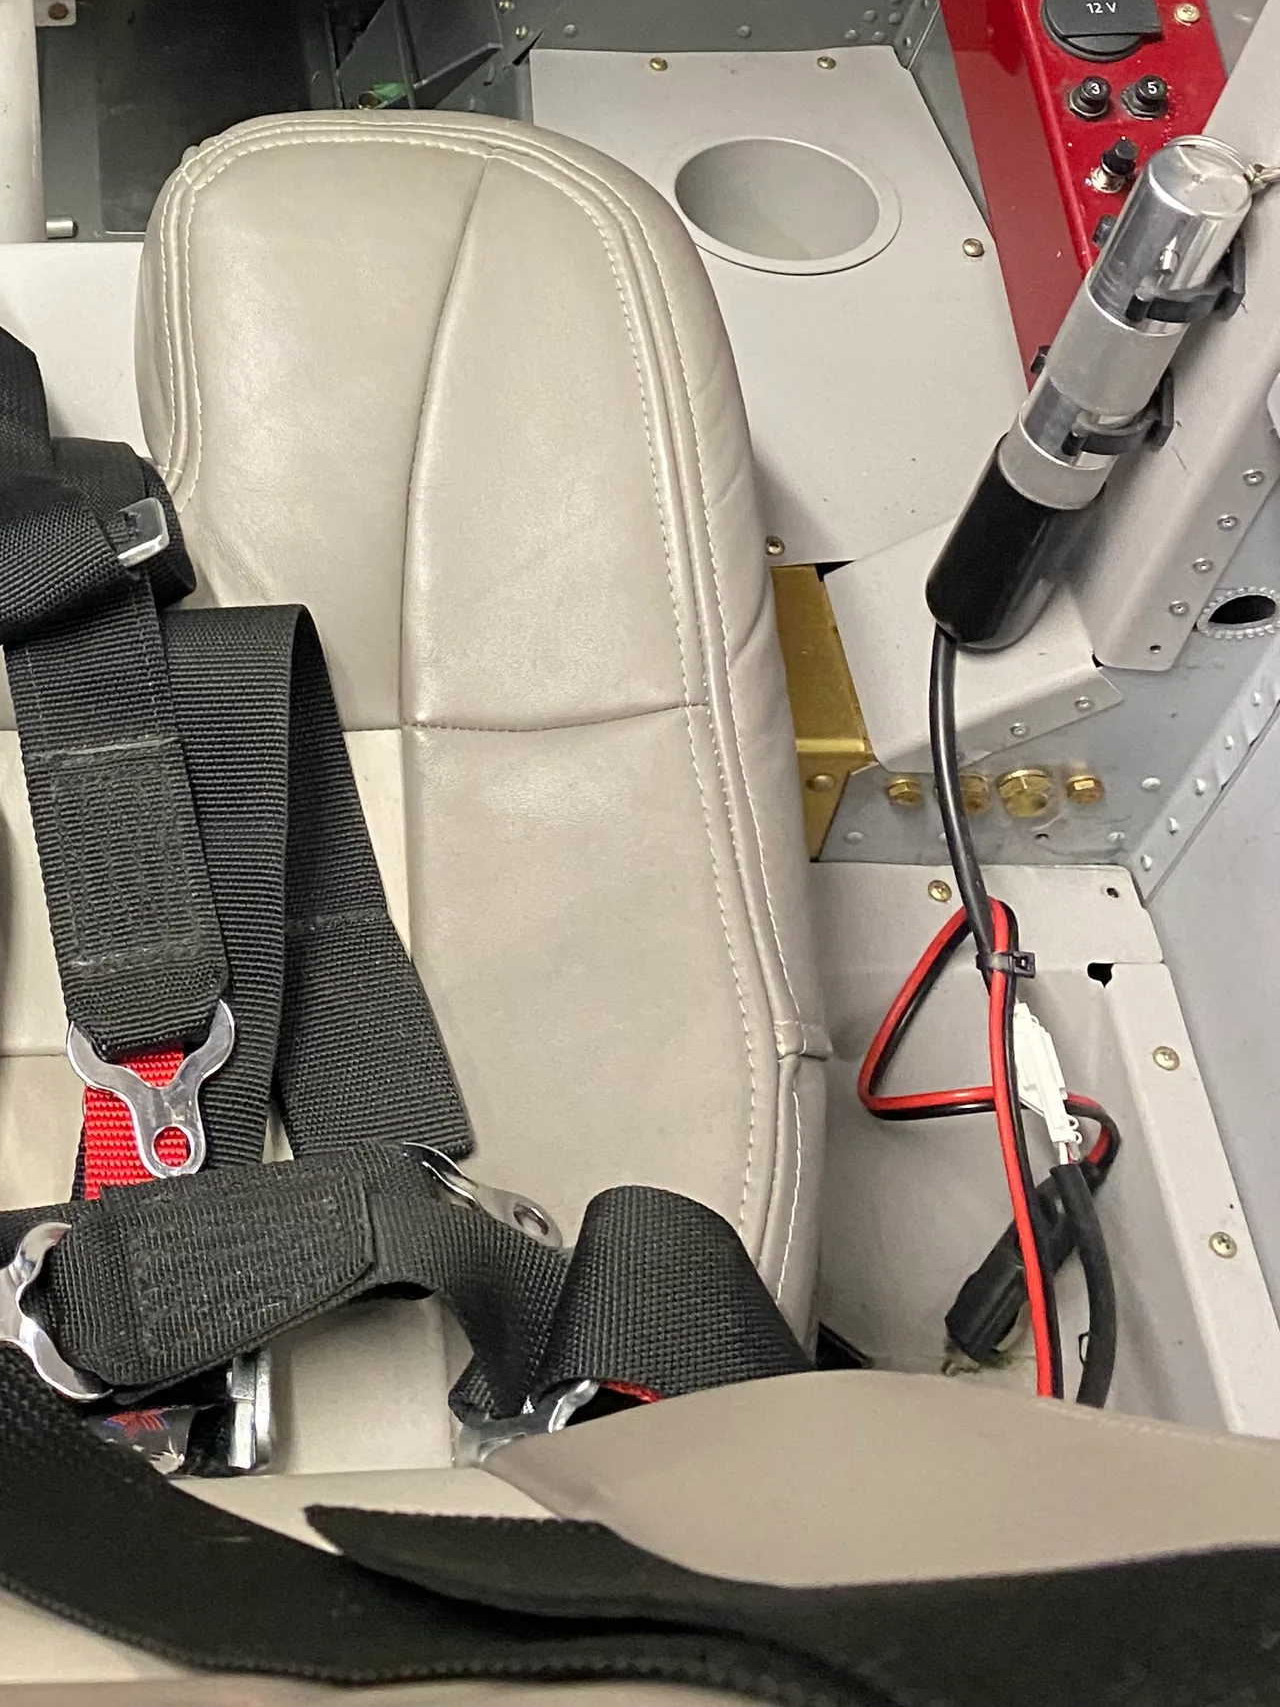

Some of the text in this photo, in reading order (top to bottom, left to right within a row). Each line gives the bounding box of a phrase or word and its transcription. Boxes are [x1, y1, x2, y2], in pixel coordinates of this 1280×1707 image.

[1087, 2, 1115, 13] 12 V
[1090, 83, 1100, 94] 3
[1148, 81, 1157, 94] 5
